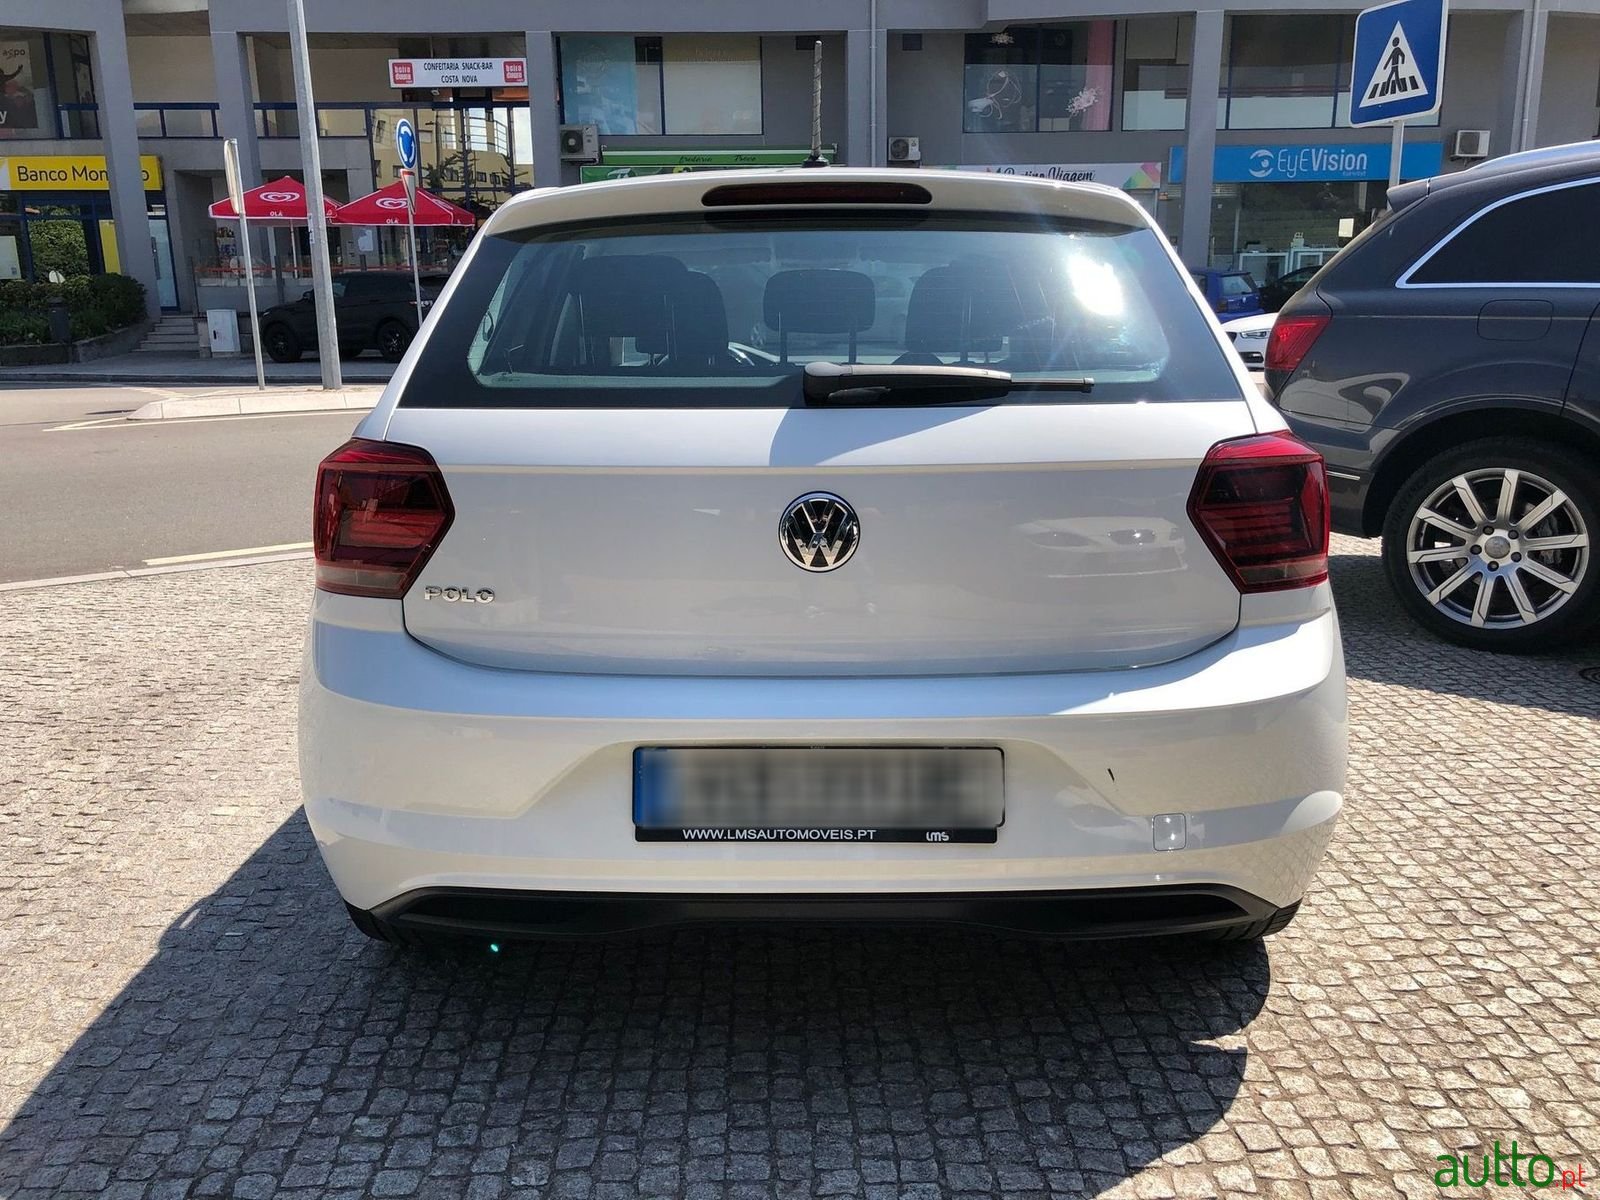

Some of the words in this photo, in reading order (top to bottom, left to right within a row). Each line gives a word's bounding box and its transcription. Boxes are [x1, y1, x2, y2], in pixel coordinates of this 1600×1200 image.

[423, 62, 460, 71] CONFEITARIA
[461, 61, 494, 71] SNACK-BAR
[441, 75, 460, 83] COSTA
[461, 75, 479, 83] NOVA
[17, 166, 68, 182] Banco
[424, 585, 496, 604] POLO
[682, 828, 877, 841] WWW.LMSAUTOMOVEIS.PT
